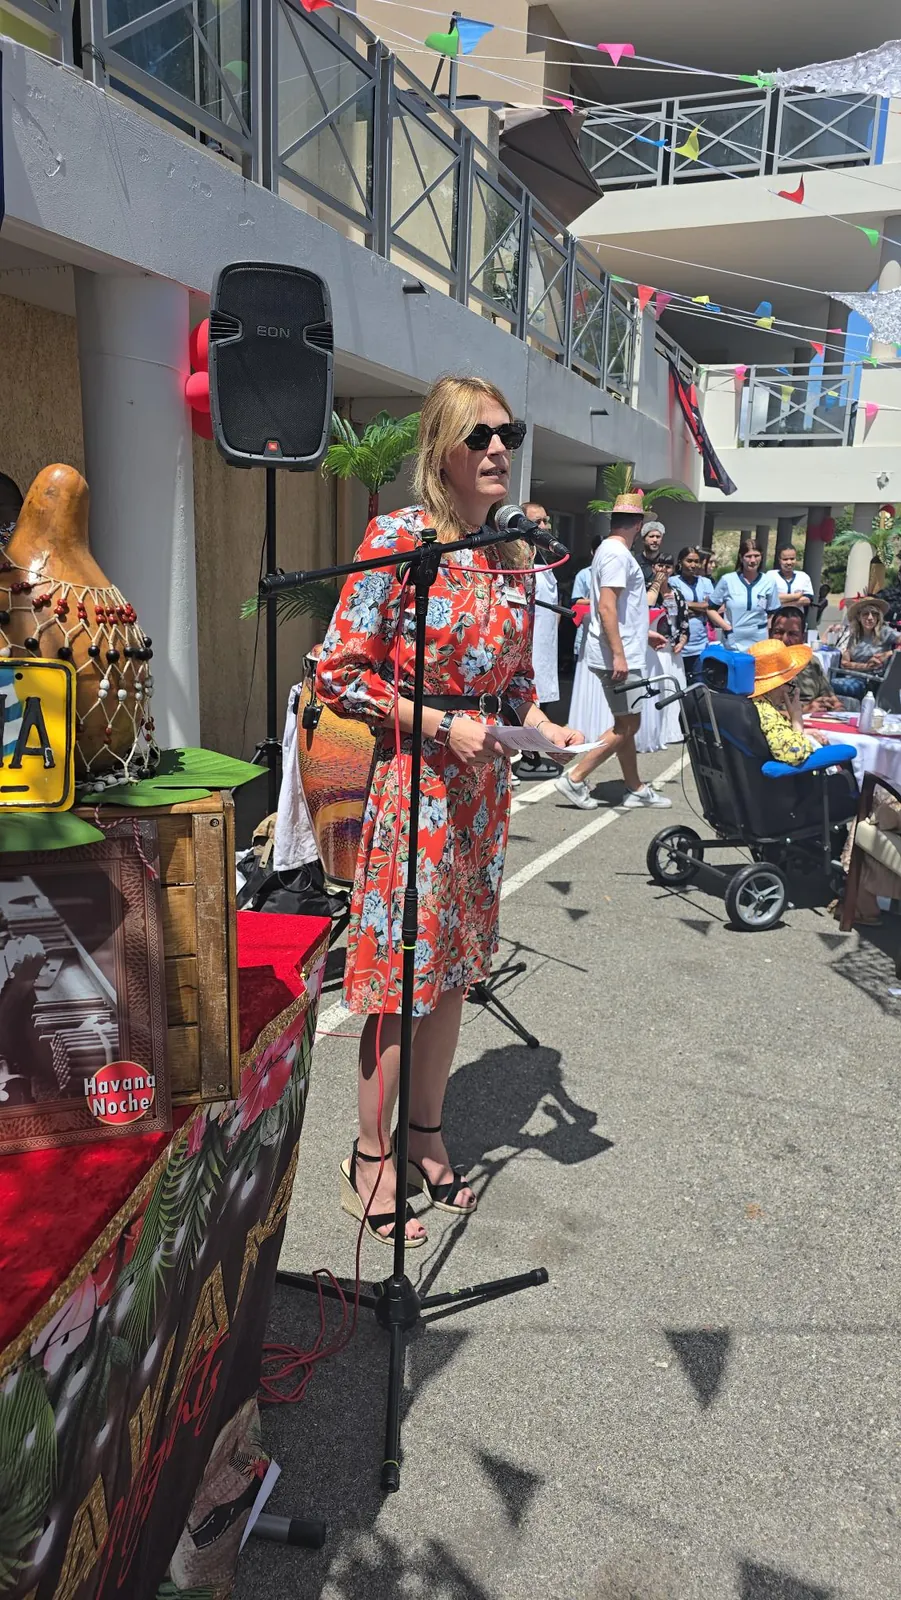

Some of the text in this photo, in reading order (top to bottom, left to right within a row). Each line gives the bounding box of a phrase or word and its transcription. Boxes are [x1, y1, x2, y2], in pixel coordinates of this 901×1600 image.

[256, 325, 290, 338] EON
[0, 694, 55, 769] A
[83, 1074, 156, 1096] Havana
[92, 1092, 150, 1117] Noche
